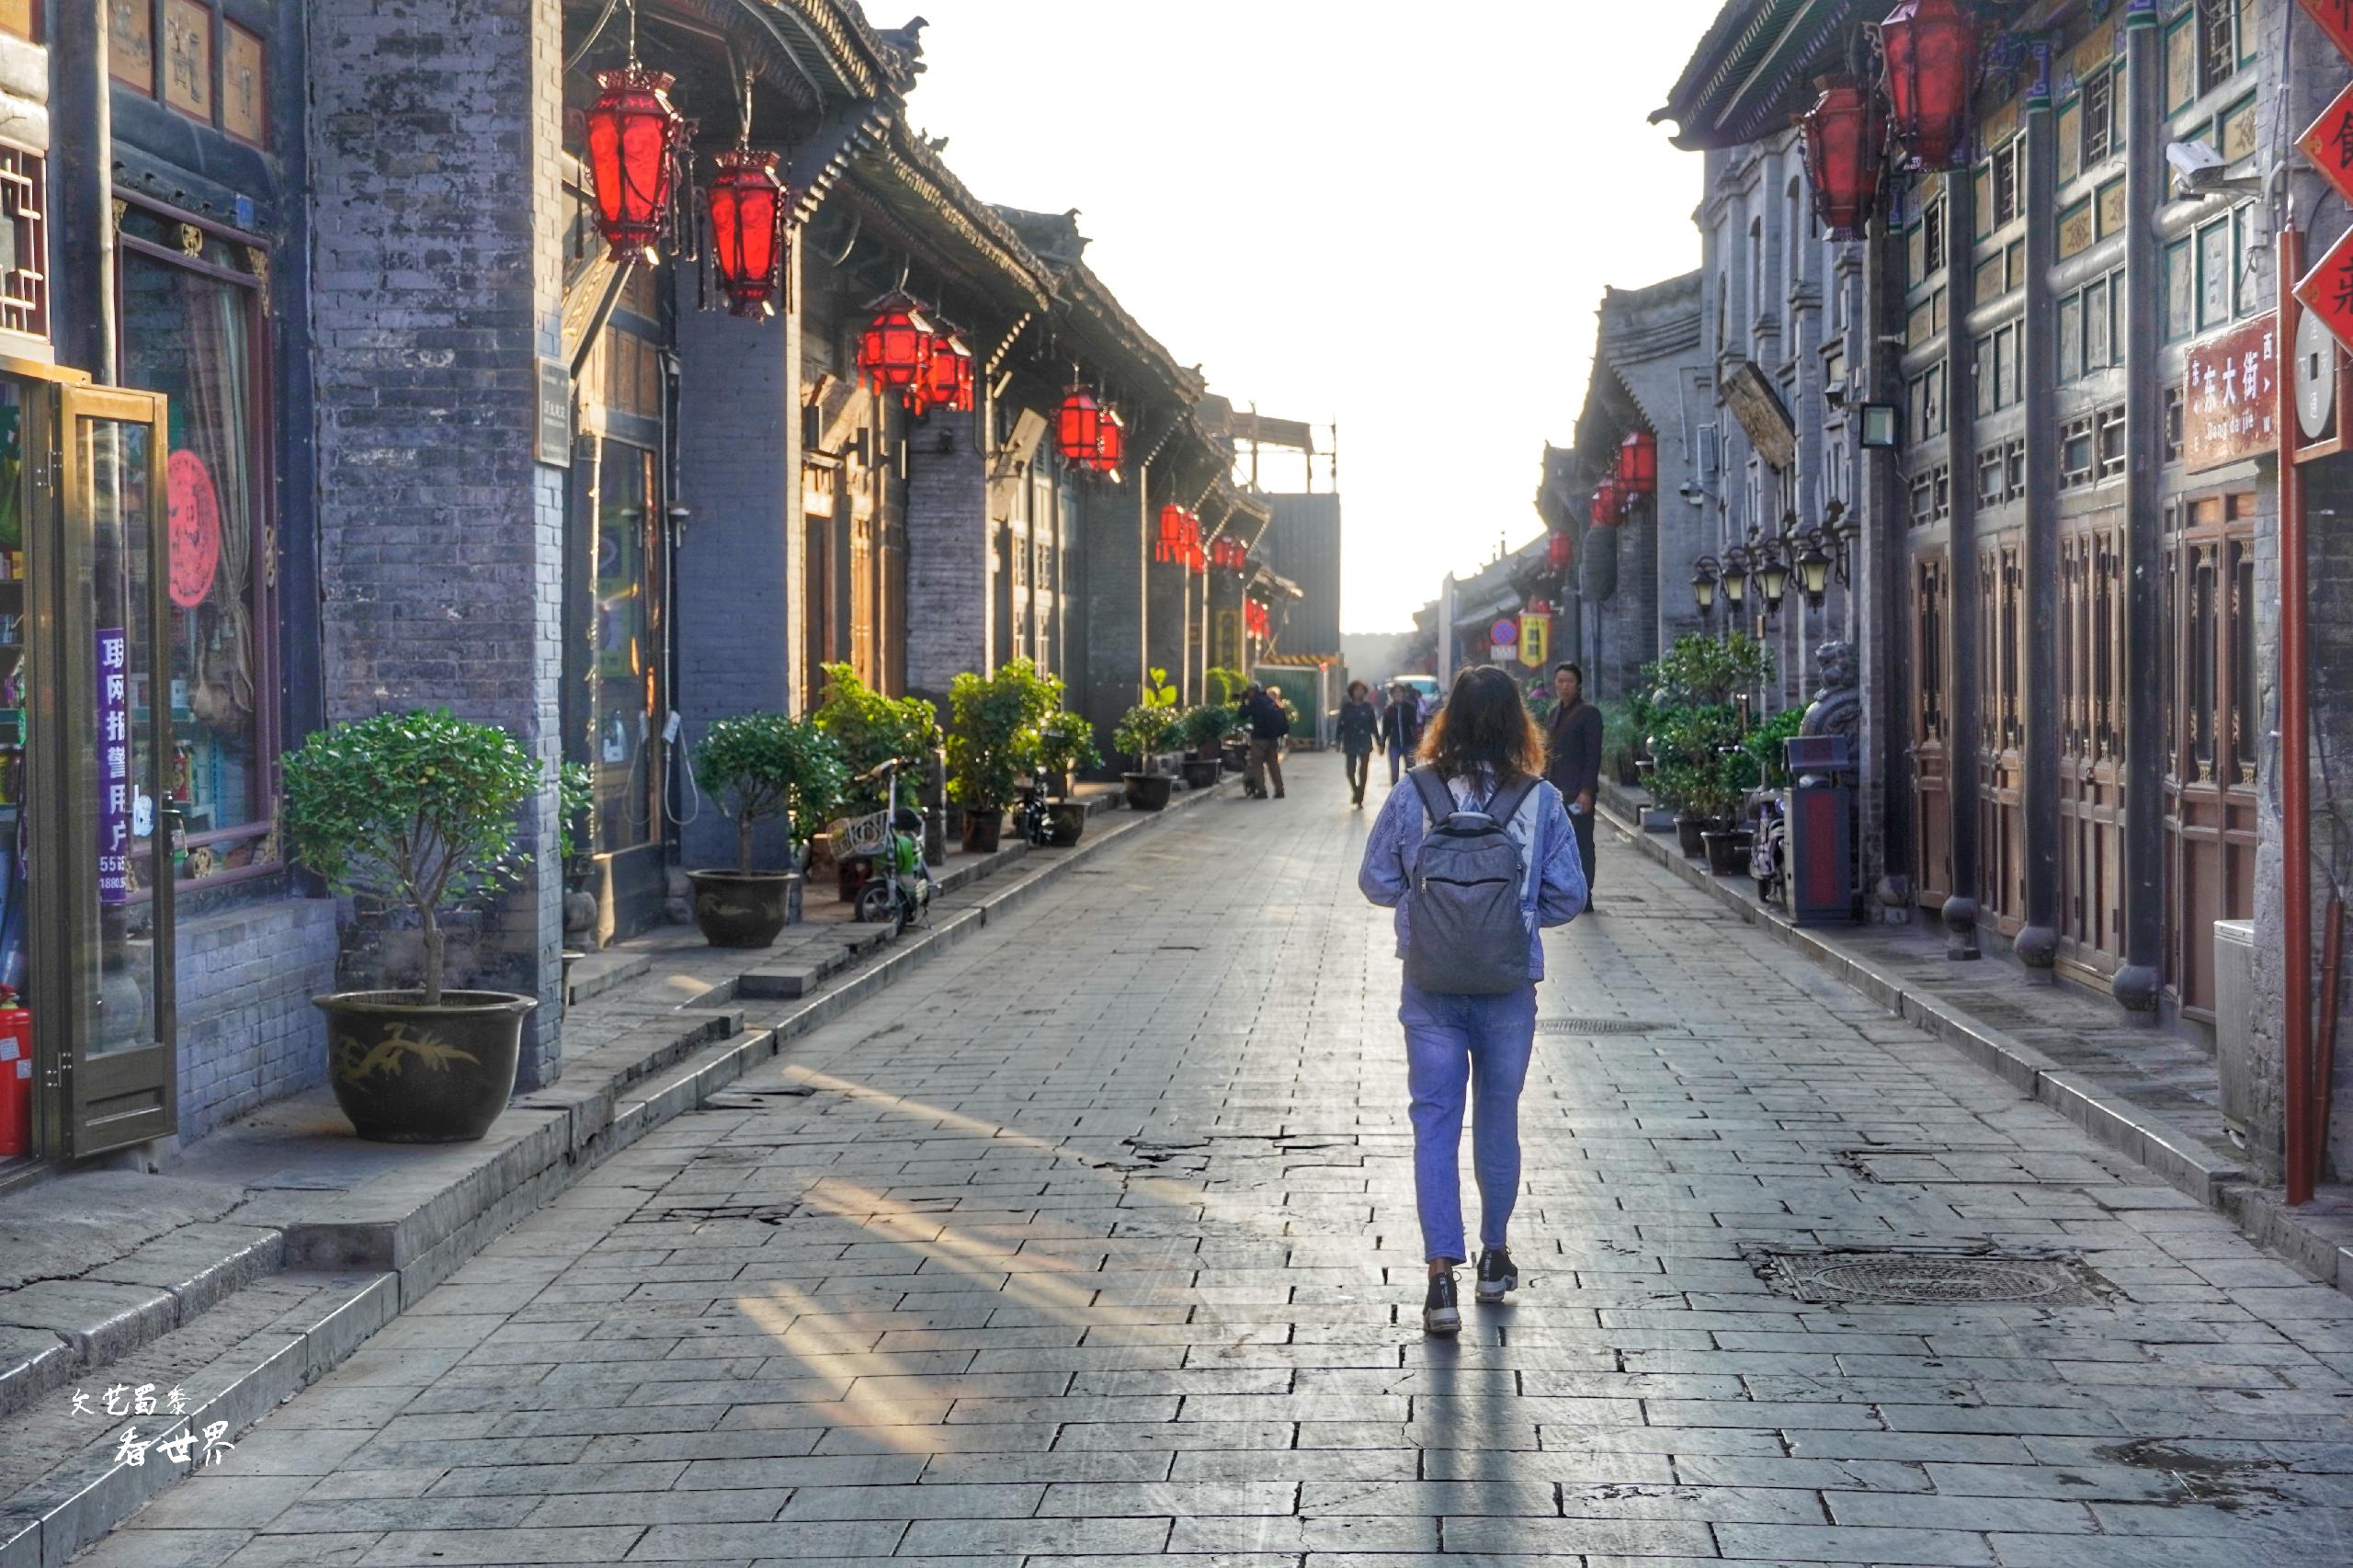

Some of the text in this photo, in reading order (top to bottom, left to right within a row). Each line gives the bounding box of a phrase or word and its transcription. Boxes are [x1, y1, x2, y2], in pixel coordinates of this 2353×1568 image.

[2263, 332, 2273, 360] 西
[2203, 351, 2258, 413] 东大街
